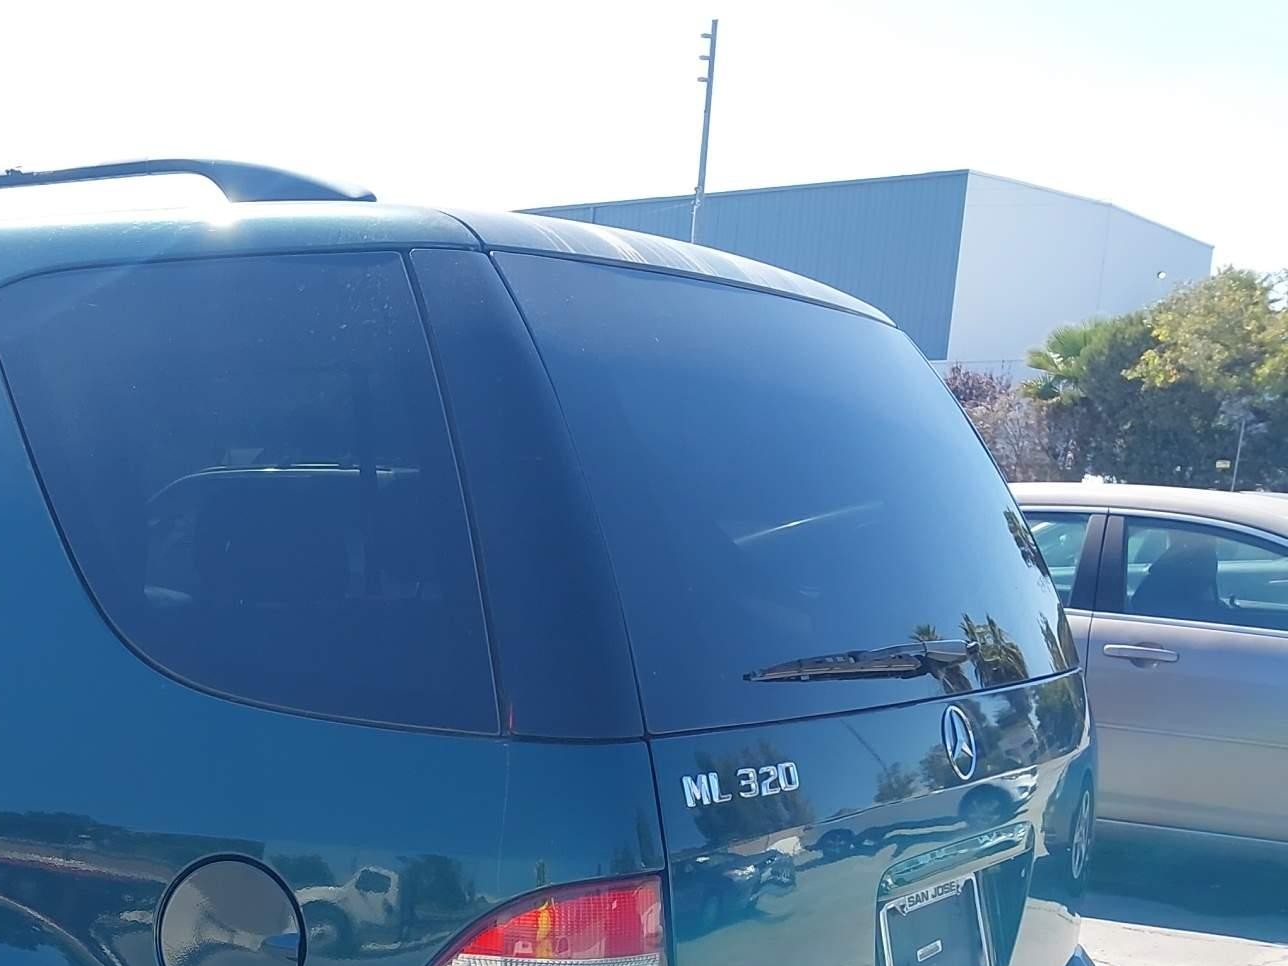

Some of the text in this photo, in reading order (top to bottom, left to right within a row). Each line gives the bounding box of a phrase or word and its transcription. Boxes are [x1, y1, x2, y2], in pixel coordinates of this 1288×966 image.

[682, 762, 800, 808] ML 320
[907, 881, 957, 907] SAN JOSE
